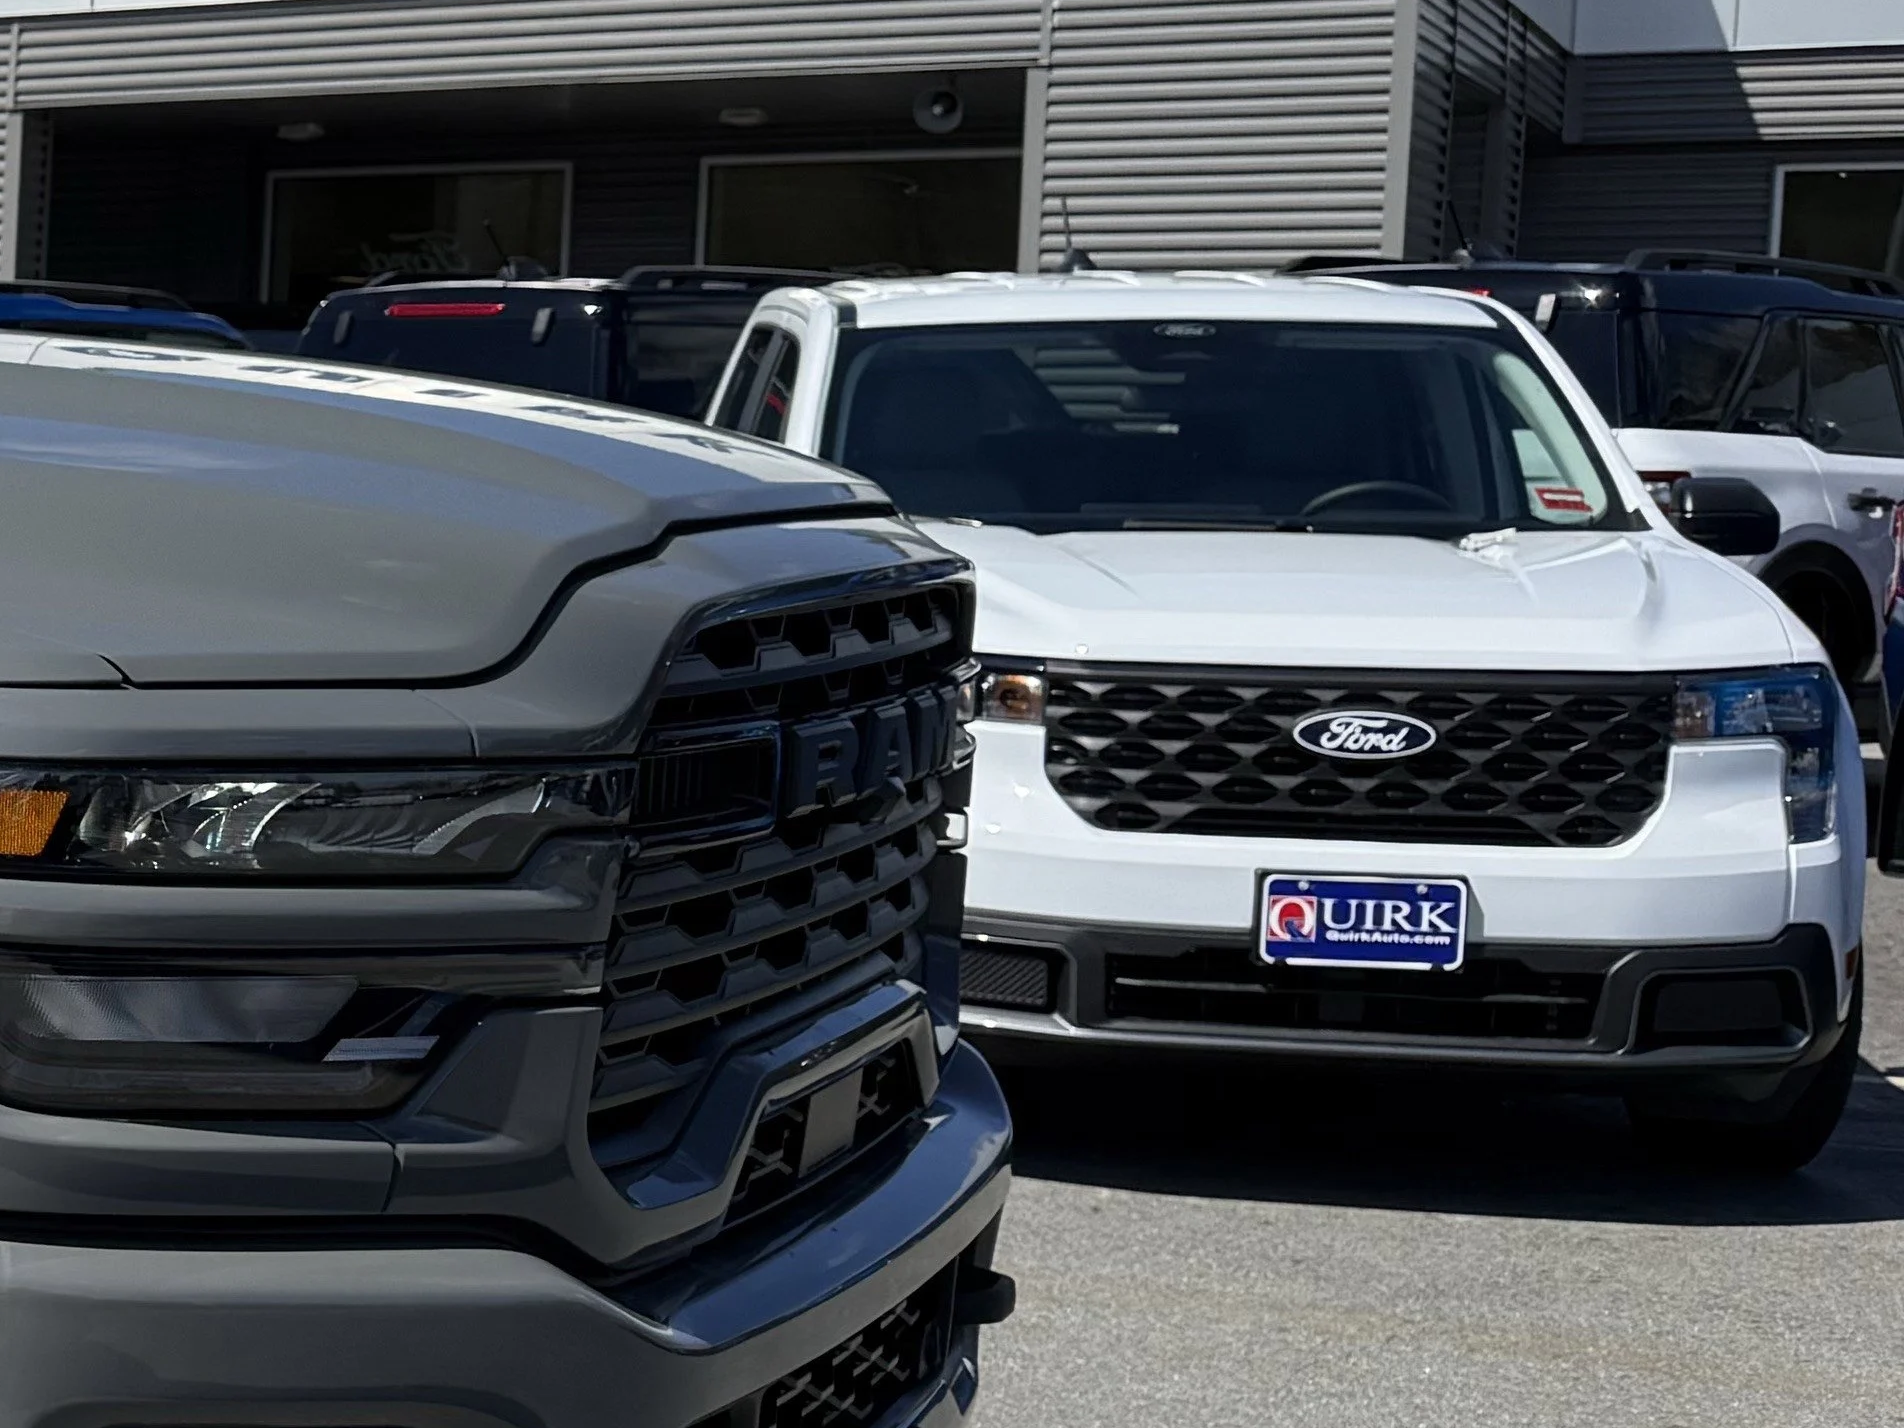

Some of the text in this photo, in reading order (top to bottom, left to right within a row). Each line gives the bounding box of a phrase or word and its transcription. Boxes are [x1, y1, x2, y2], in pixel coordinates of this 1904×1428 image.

[787, 684, 958, 819] RAM
[1319, 716, 1411, 752] Ford
[1268, 895, 1459, 943] QUIRK
[1324, 929, 1452, 946] QuirkAuto.com
